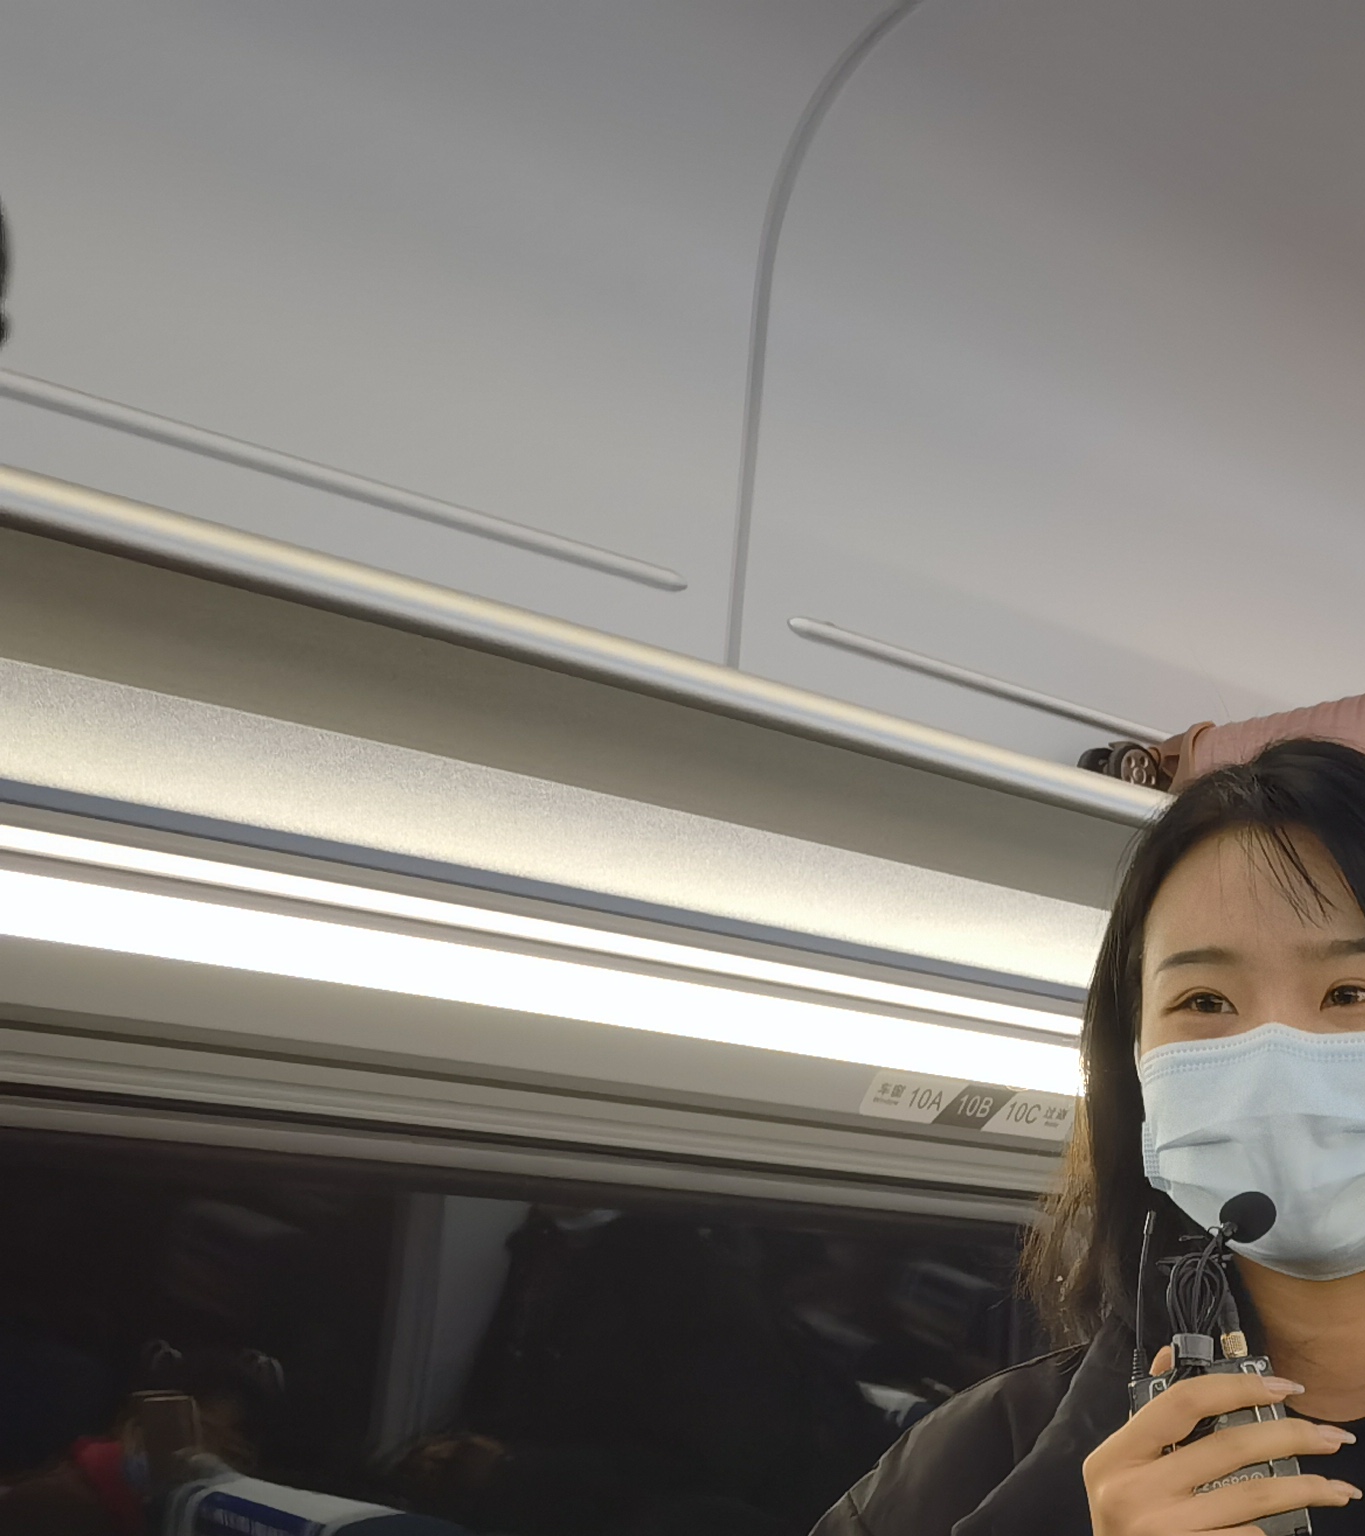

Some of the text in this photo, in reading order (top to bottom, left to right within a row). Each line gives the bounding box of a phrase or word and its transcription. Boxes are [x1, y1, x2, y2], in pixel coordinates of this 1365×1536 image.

[908, 1087, 943, 1111] 10A
[956, 1093, 994, 1118] 10B
[1006, 1101, 1042, 1124] 10C
